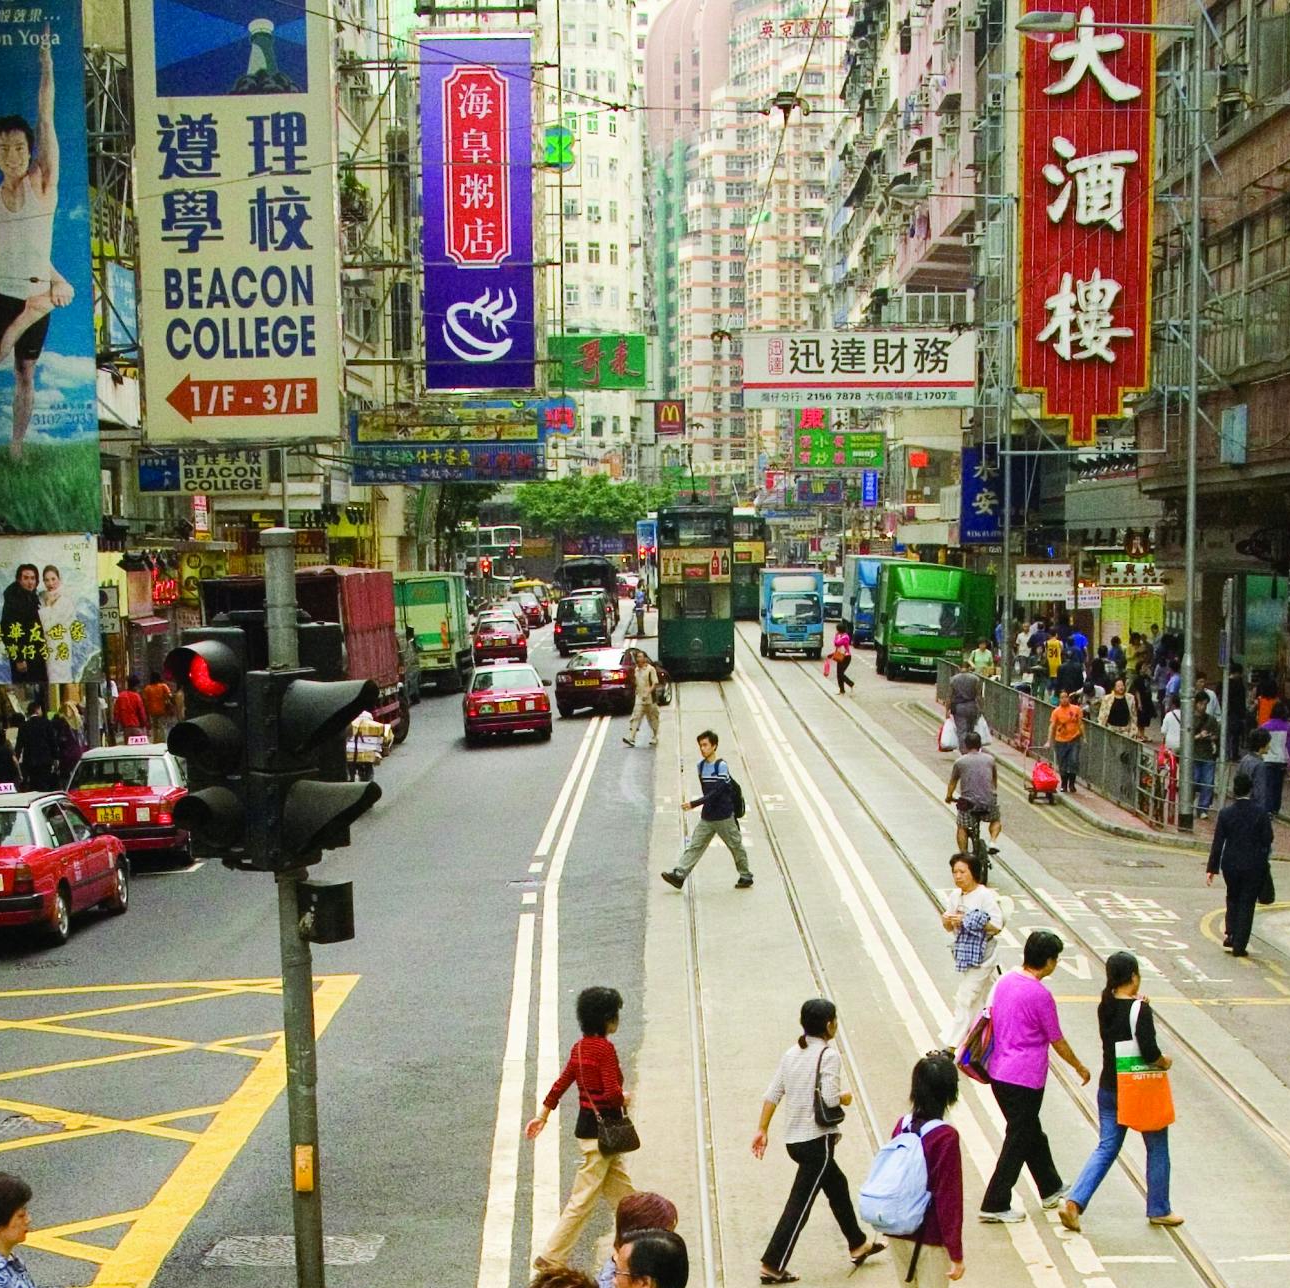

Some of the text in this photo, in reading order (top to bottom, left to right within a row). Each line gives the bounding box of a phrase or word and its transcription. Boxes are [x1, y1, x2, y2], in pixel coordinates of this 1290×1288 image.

[18, 29, 61, 50] Yoga
[156, 111, 312, 180] 遵理
[457, 83, 495, 256] 海皇粥店
[1036, 6, 1141, 364] 大酒樓
[161, 185, 314, 254] 學校
[164, 264, 315, 310] BEACON
[166, 315, 317, 361] COLLEGE
[788, 337, 952, 376] 迅達財務
[190, 385, 235, 415] 1/F
[262, 383, 309, 413] 3/F
[806, 392, 832, 401] 2156
[836, 392, 861, 401] 7878
[183, 466, 262, 479] BEACON
[183, 479, 263, 492] COLLEGE
